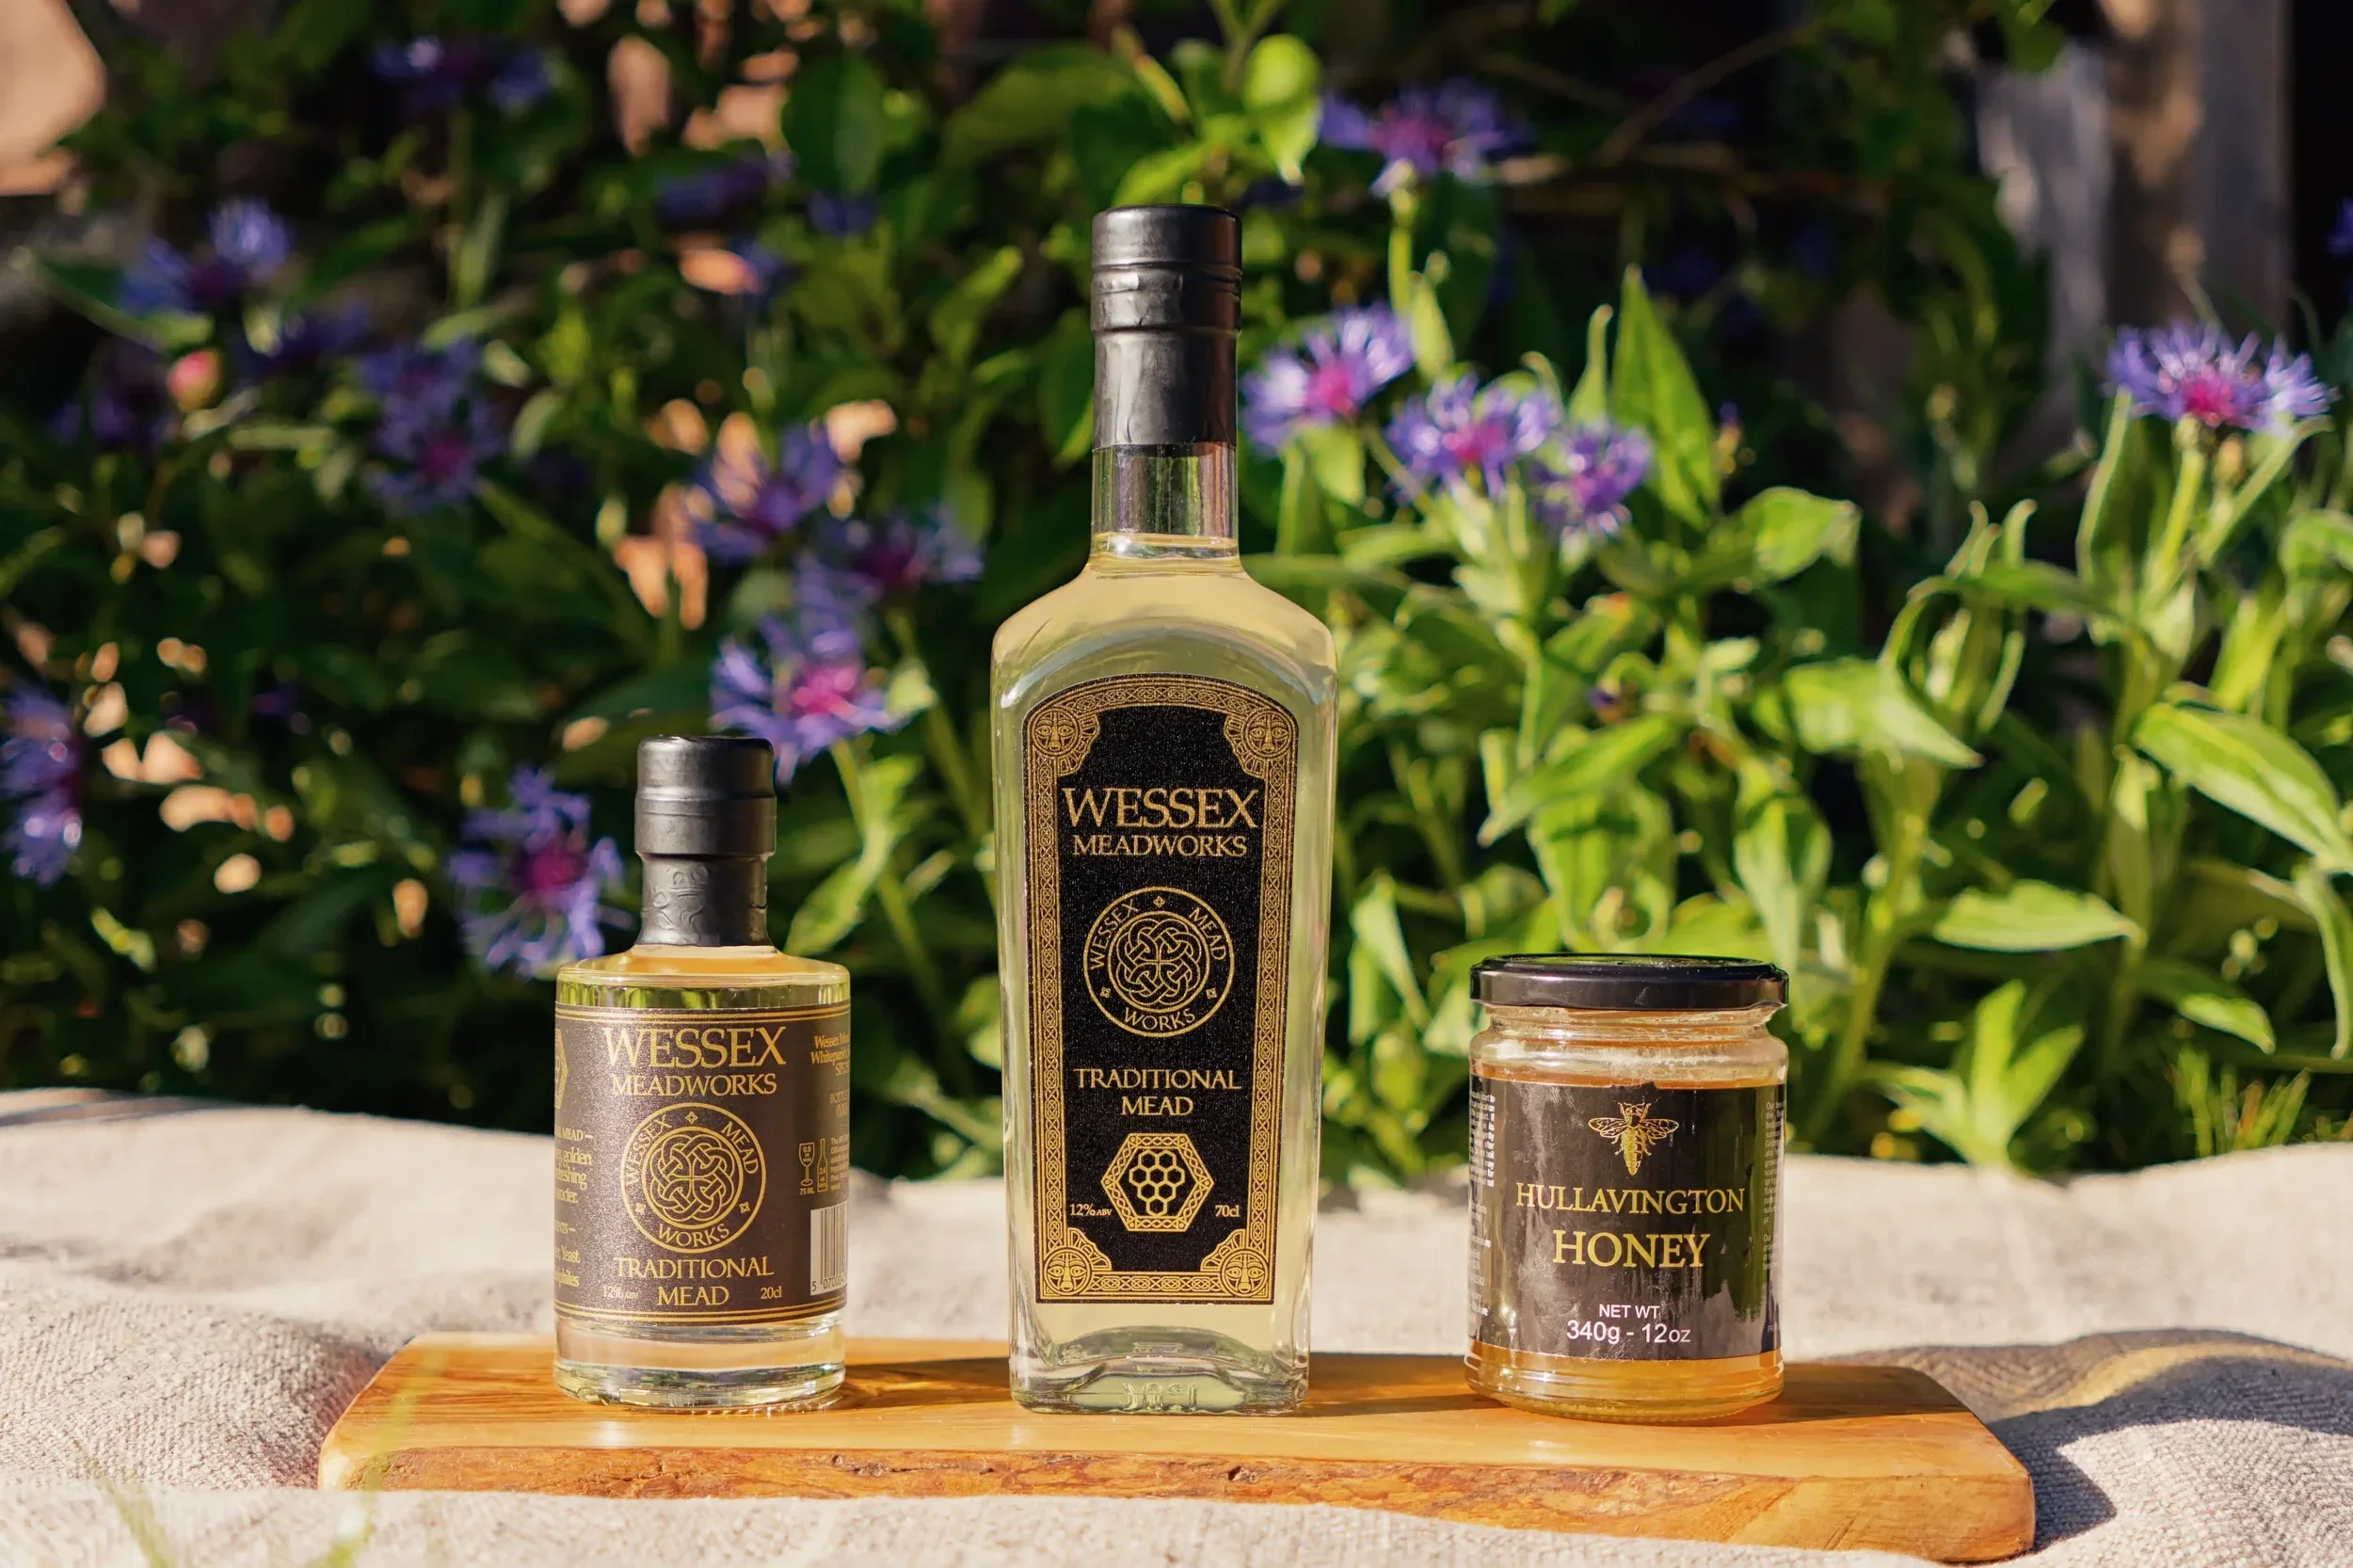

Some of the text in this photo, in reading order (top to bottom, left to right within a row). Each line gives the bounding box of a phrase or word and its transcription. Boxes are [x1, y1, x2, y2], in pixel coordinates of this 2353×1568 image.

[1061, 787, 1259, 828] WESSEX
[1072, 835, 1248, 857] MEADWORKS
[1090, 898, 1226, 1032] WESSEX MEAD WORKS
[602, 1026, 786, 1068] WESSEX
[612, 1074, 777, 1096] MEADWORKS
[1073, 1068, 1242, 1090] TRADITIONAL
[1120, 1096, 1194, 1116] MEAD
[563, 1146, 594, 1167] golden
[625, 1114, 760, 1248] WESSEX MEAD WORKS
[1515, 1182, 1746, 1215] HULLAVINGTON
[1214, 1204, 1241, 1218] 70cl
[1552, 1229, 1711, 1269] HONEY
[612, 1256, 775, 1280] TRADITIONAL
[657, 1287, 730, 1306] MEAD
[760, 1285, 783, 1300] 20cl
[1599, 1304, 1660, 1319] NET WT
[1566, 1320, 1621, 1344] 340g
[1641, 1324, 1691, 1343] 12oz
